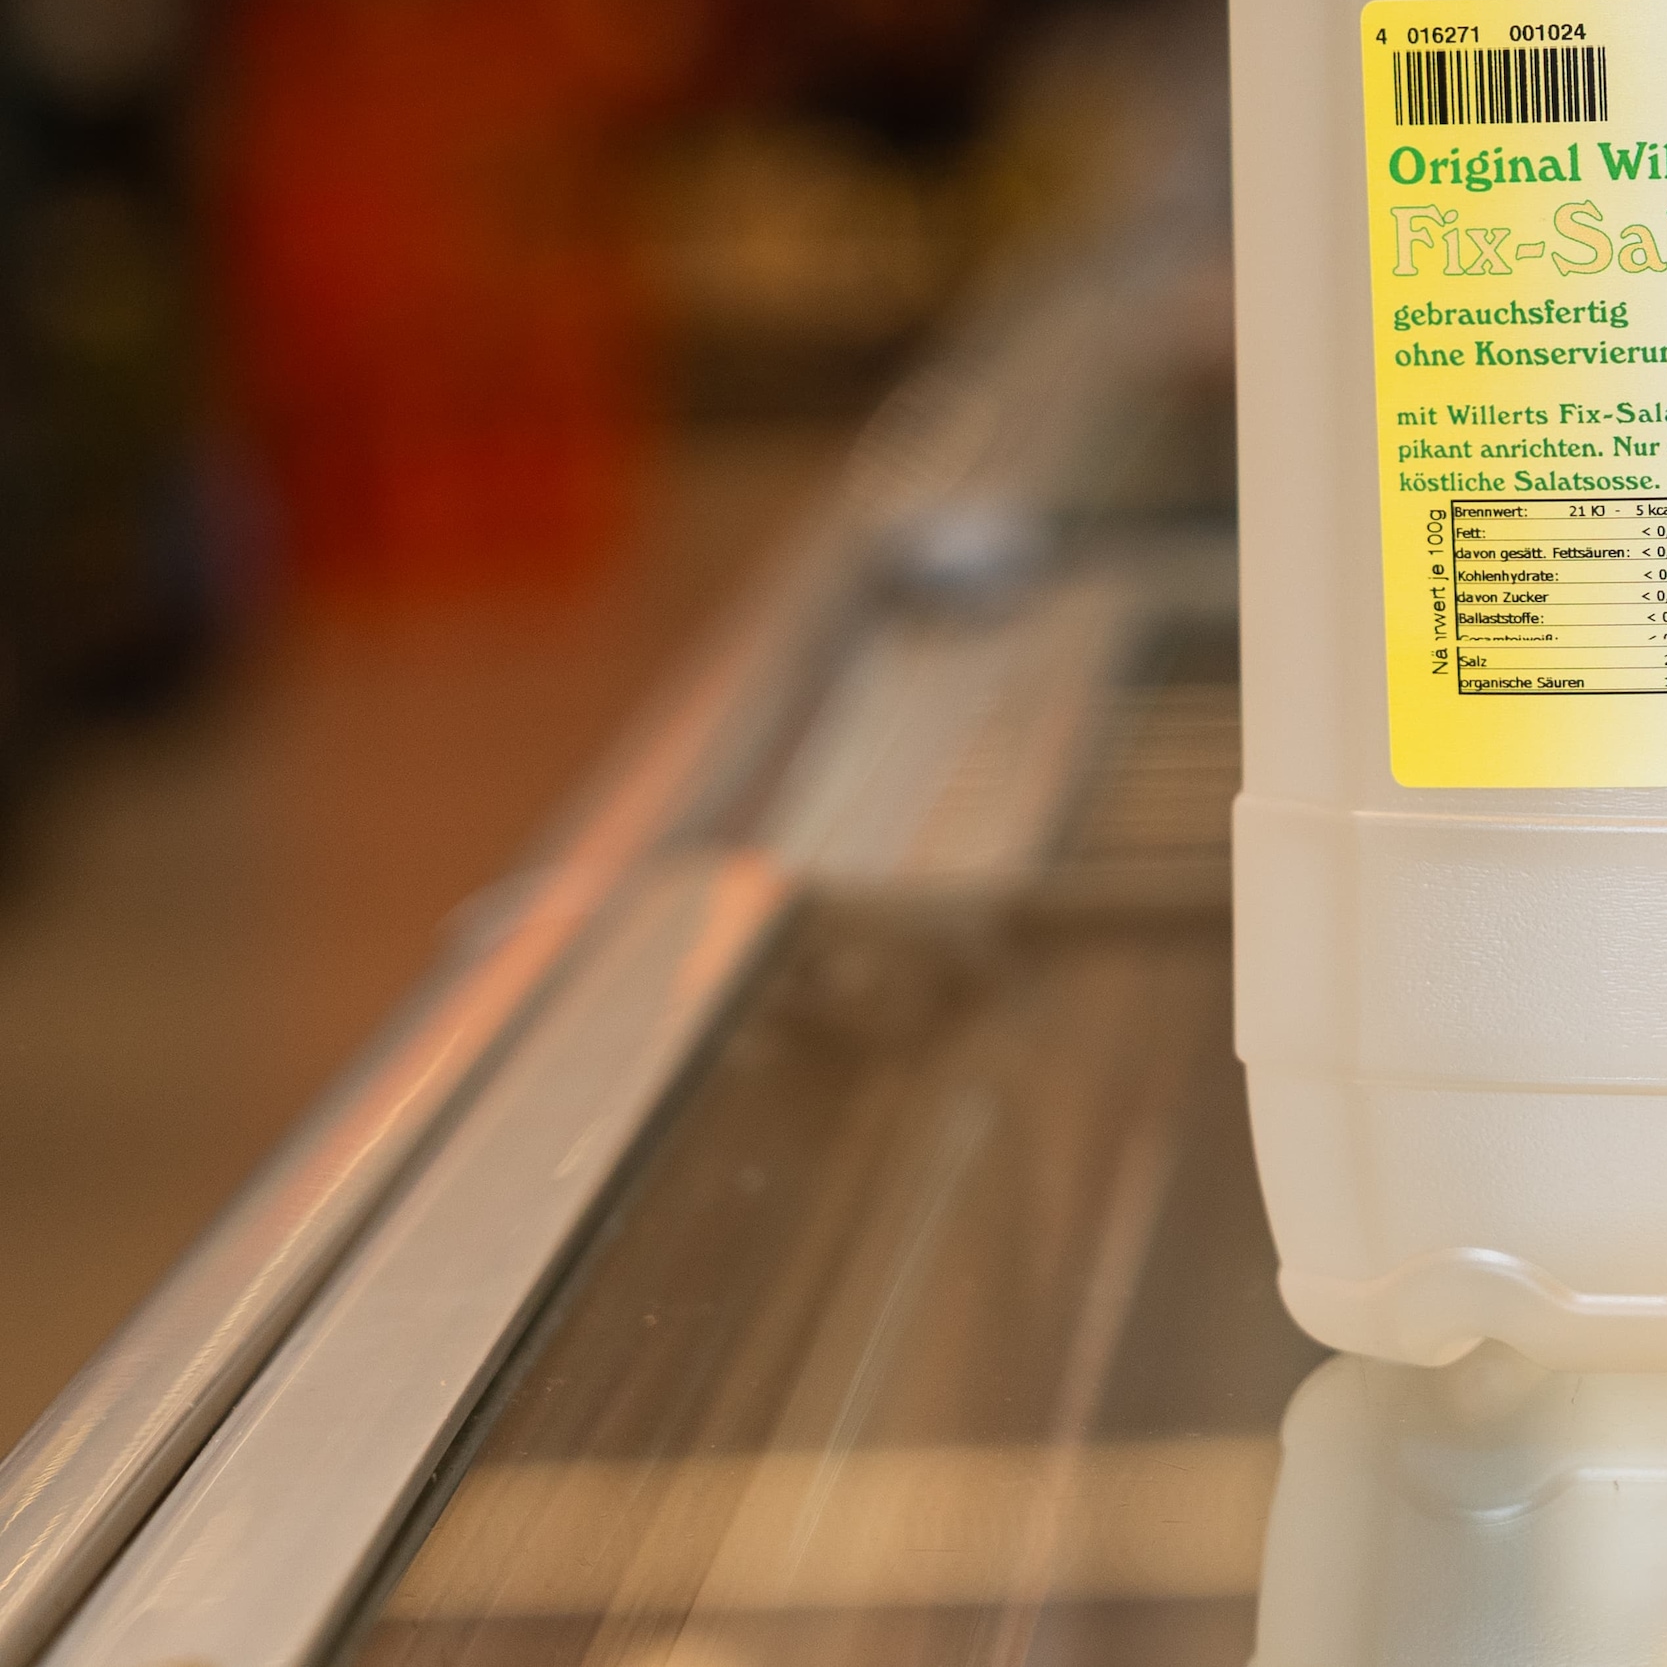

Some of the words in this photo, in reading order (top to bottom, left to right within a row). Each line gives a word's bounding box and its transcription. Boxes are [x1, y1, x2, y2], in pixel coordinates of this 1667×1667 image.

[1376, 29, 1387, 44] 4
[1407, 27, 1479, 43] 016271
[1509, 24, 1586, 41] 001024
[1389, 143, 1581, 192] Original
[1393, 299, 1629, 330] gebrauchsfertig
[1394, 341, 1465, 367] ohne
[1398, 406, 1437, 426] mit
[1447, 403, 1549, 425] Willerts
[1398, 440, 1473, 462] pikant
[1480, 438, 1603, 458] anrichten.
[1613, 436, 1660, 456] Nur
[1399, 472, 1506, 492] köstliche
[1514, 470, 1660, 491] Salatsosse.
[1455, 506, 1528, 518] Brennwert:
[1569, 506, 1585, 517] 21
[1592, 506, 1605, 517] KJ
[1636, 505, 1643, 516] 5
[1456, 528, 1486, 539] Fett:
[1456, 549, 1496, 559] davon
[1501, 548, 1546, 561] gesätt.
[1552, 548, 1630, 559] Fettsäuren:
[1458, 571, 1559, 584] Kohlenhydrate:
[1457, 592, 1497, 603] davon
[1503, 592, 1549, 603] Zucker
[1458, 612, 1544, 625] Ballaststoffe:
[1459, 657, 1487, 667] Salz
[1460, 678, 1532, 690] organische
[1537, 677, 1584, 688] Säuren
